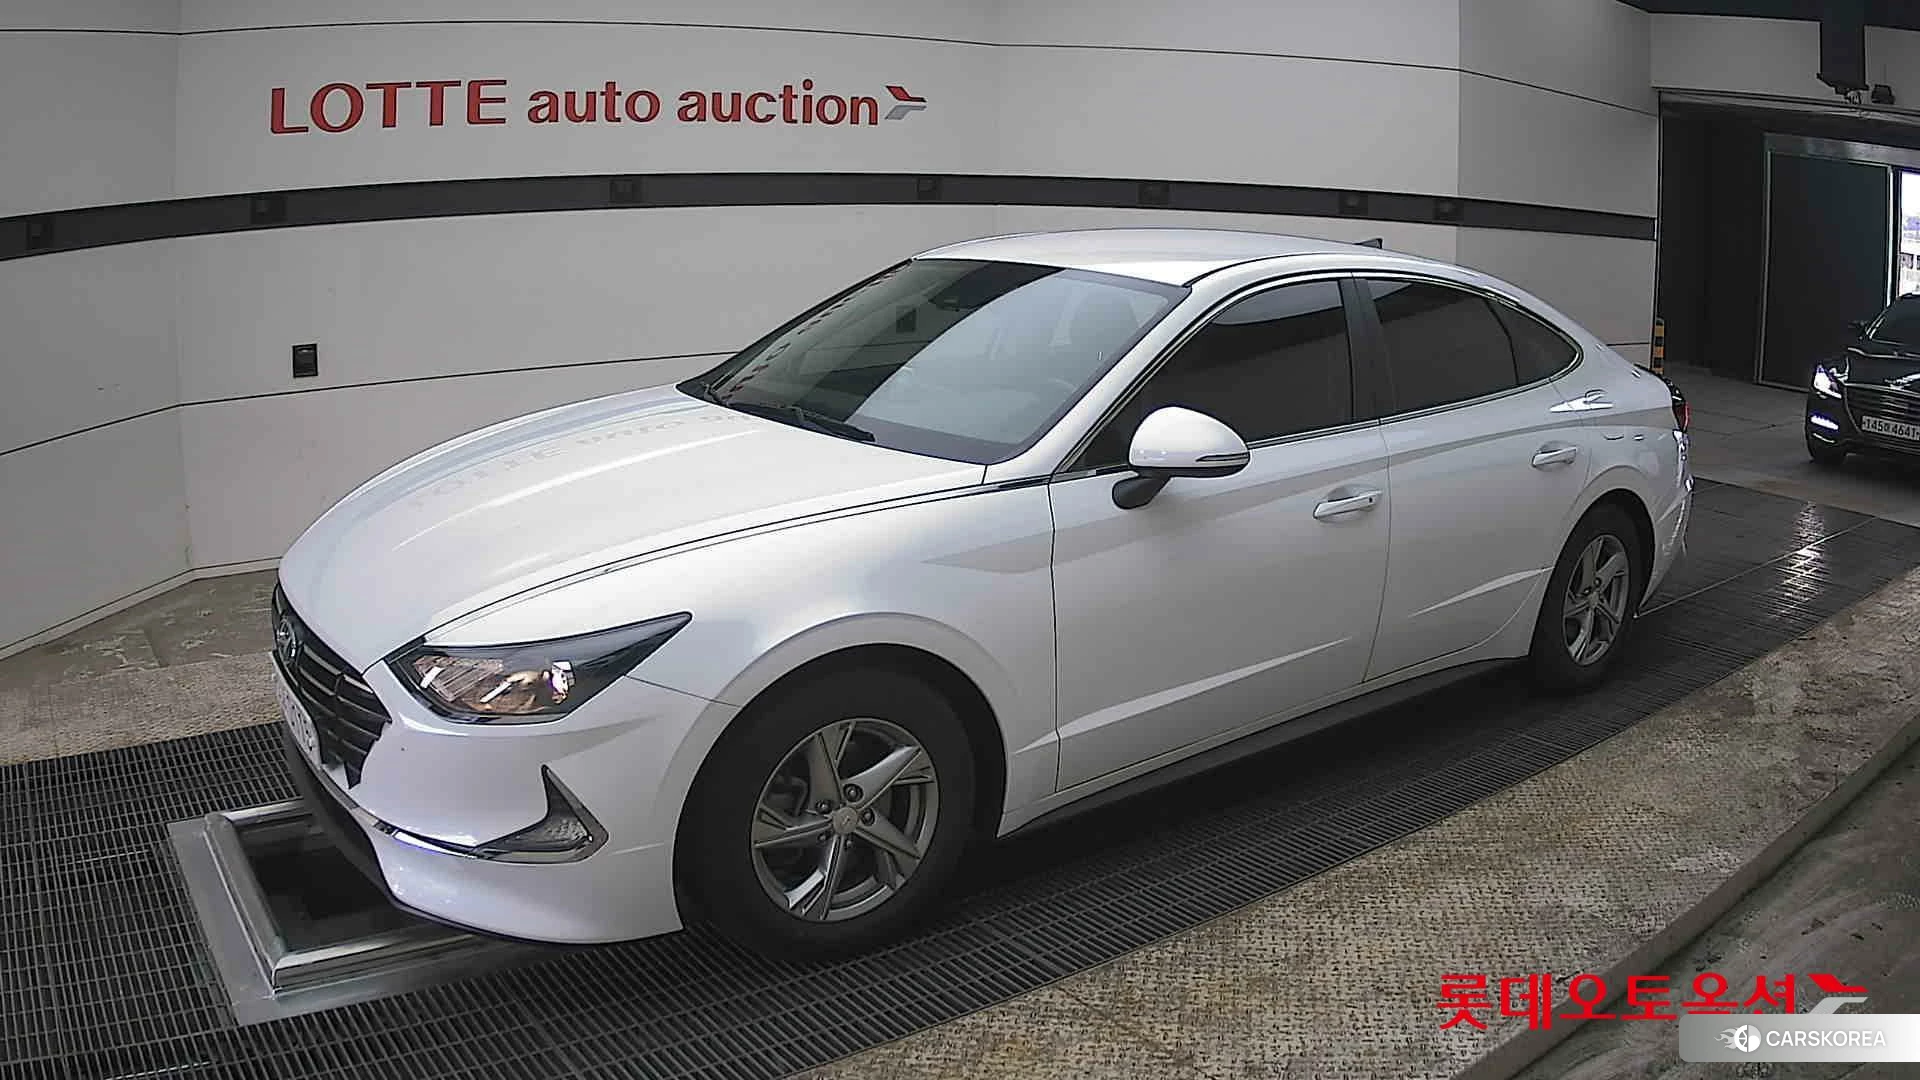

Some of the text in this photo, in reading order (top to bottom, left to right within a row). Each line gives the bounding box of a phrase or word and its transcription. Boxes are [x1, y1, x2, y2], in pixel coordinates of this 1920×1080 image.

[270, 79, 879, 136] LOTTE auto auction
